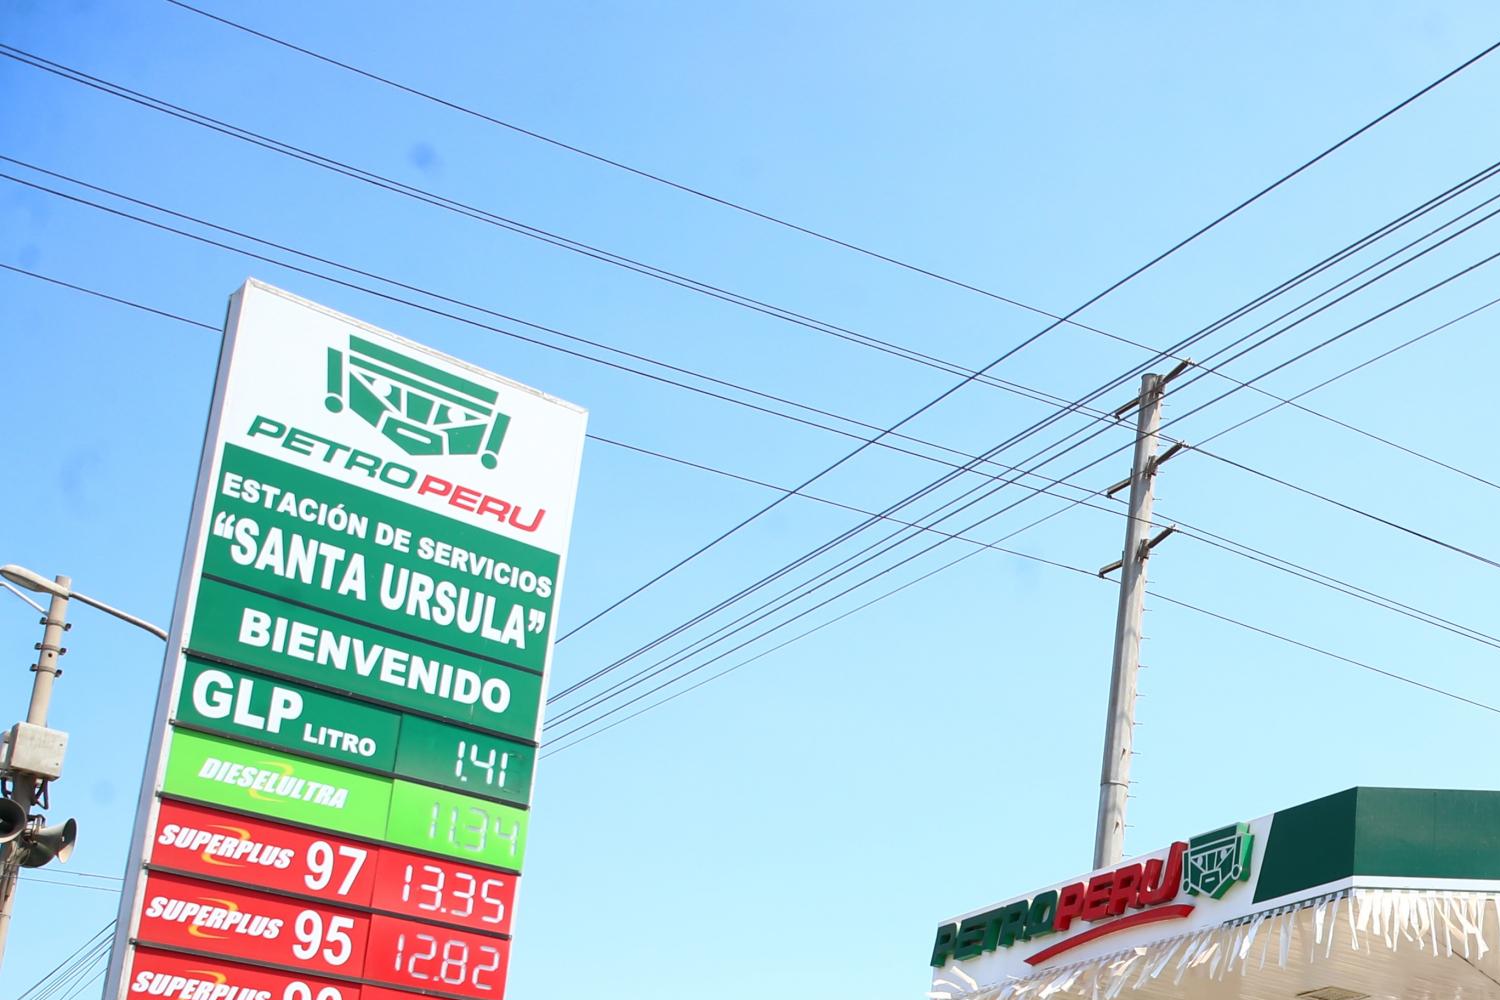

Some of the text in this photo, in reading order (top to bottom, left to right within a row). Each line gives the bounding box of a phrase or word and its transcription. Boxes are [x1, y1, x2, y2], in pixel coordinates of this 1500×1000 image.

[246, 415, 547, 533] PETROPERU
[221, 470, 553, 599] ESTACIÓN DE SERVICIOS
[239, 607, 511, 714] BIENVENIDO
[192, 670, 303, 734] GLP
[303, 722, 376, 757] LITRO
[198, 757, 350, 809] DIESELULTRA
[158, 823, 294, 870] SUPERPLUS
[304, 840, 368, 896] 97
[930, 841, 1189, 968] PETROPERU
[145, 896, 284, 940] SUPERPLUS
[292, 909, 355, 966] 95
